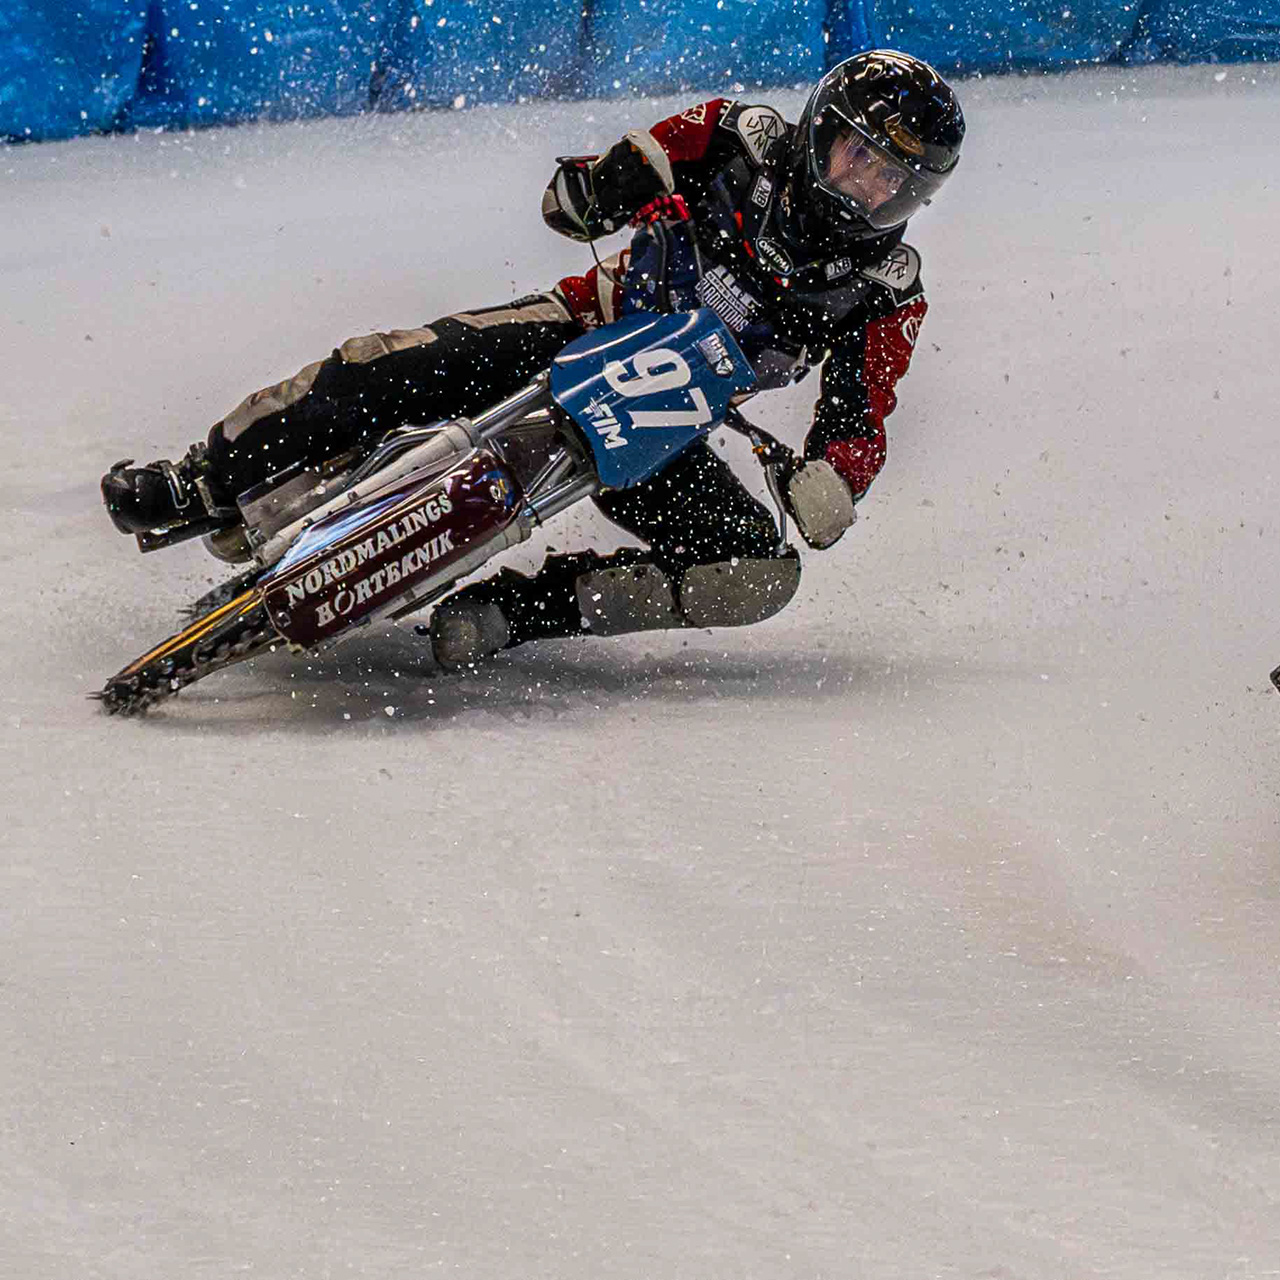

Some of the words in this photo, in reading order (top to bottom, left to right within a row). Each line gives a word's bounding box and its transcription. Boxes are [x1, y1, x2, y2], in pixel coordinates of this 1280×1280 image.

[578, 397, 629, 451] FIM
[602, 348, 713, 429] 97
[284, 491, 454, 608] NORDMALINGS
